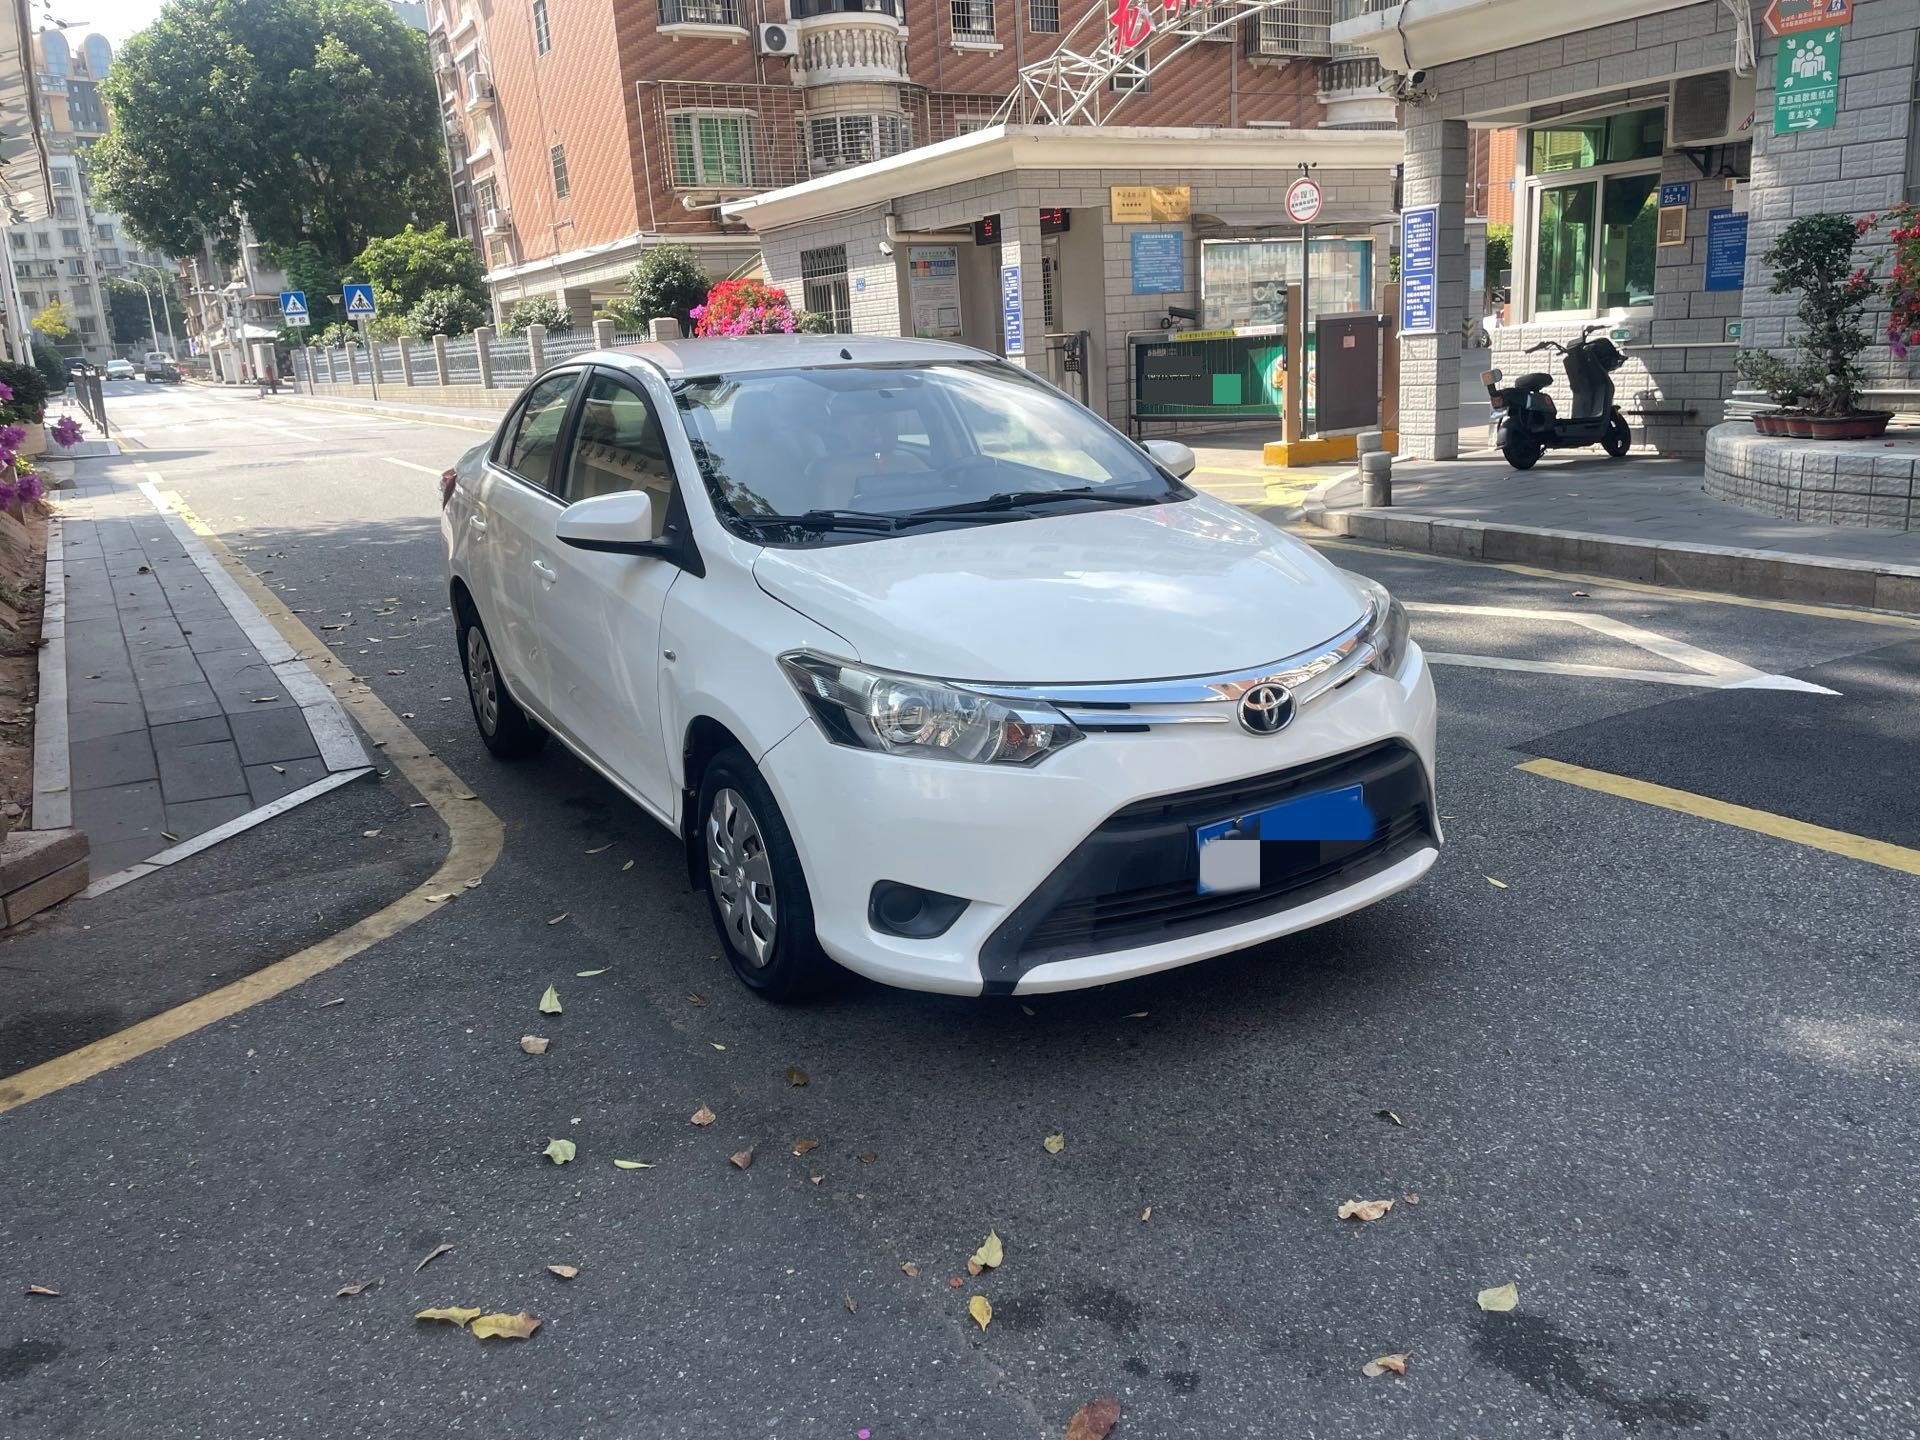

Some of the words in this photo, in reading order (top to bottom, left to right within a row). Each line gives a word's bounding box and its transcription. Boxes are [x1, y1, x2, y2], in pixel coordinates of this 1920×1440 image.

[1778, 89, 1834, 105] 紧急疏散集结点
